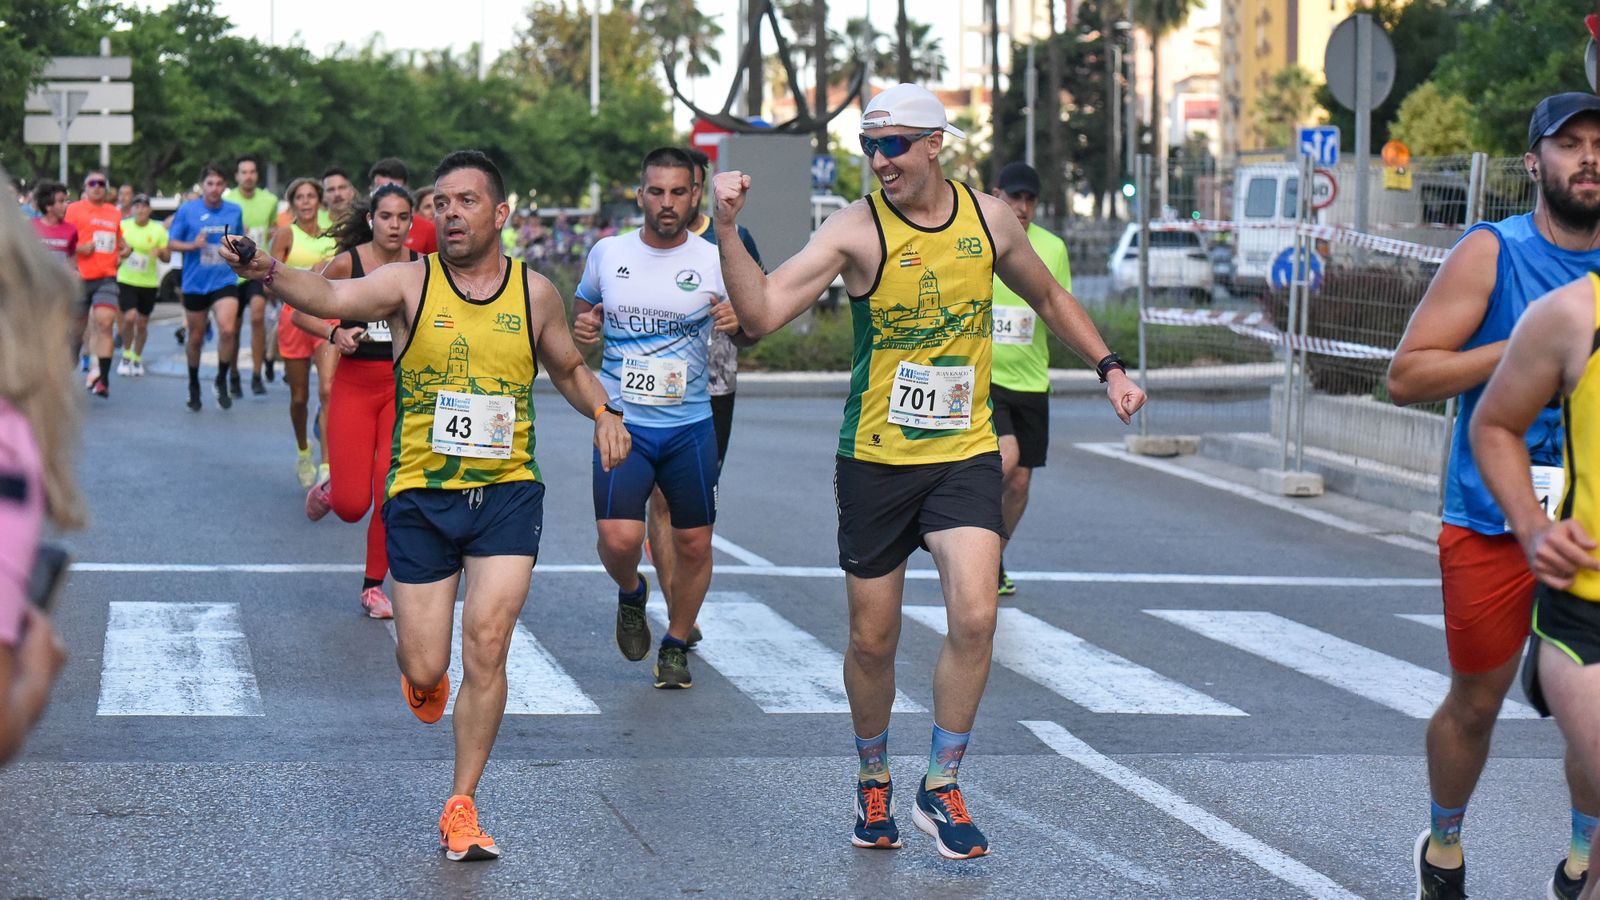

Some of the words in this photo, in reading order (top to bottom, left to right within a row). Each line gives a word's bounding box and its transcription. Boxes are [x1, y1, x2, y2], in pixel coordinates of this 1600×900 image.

[618, 304, 641, 315] CLUB
[642, 307, 687, 320] DEPORTIVO
[607, 311, 626, 330] EL
[629, 315, 700, 337] CUERVO
[625, 371, 656, 392] 228
[899, 367, 914, 379] XXI
[440, 396, 455, 407] XXI
[899, 385, 936, 412] 701
[445, 415, 472, 439] 43
